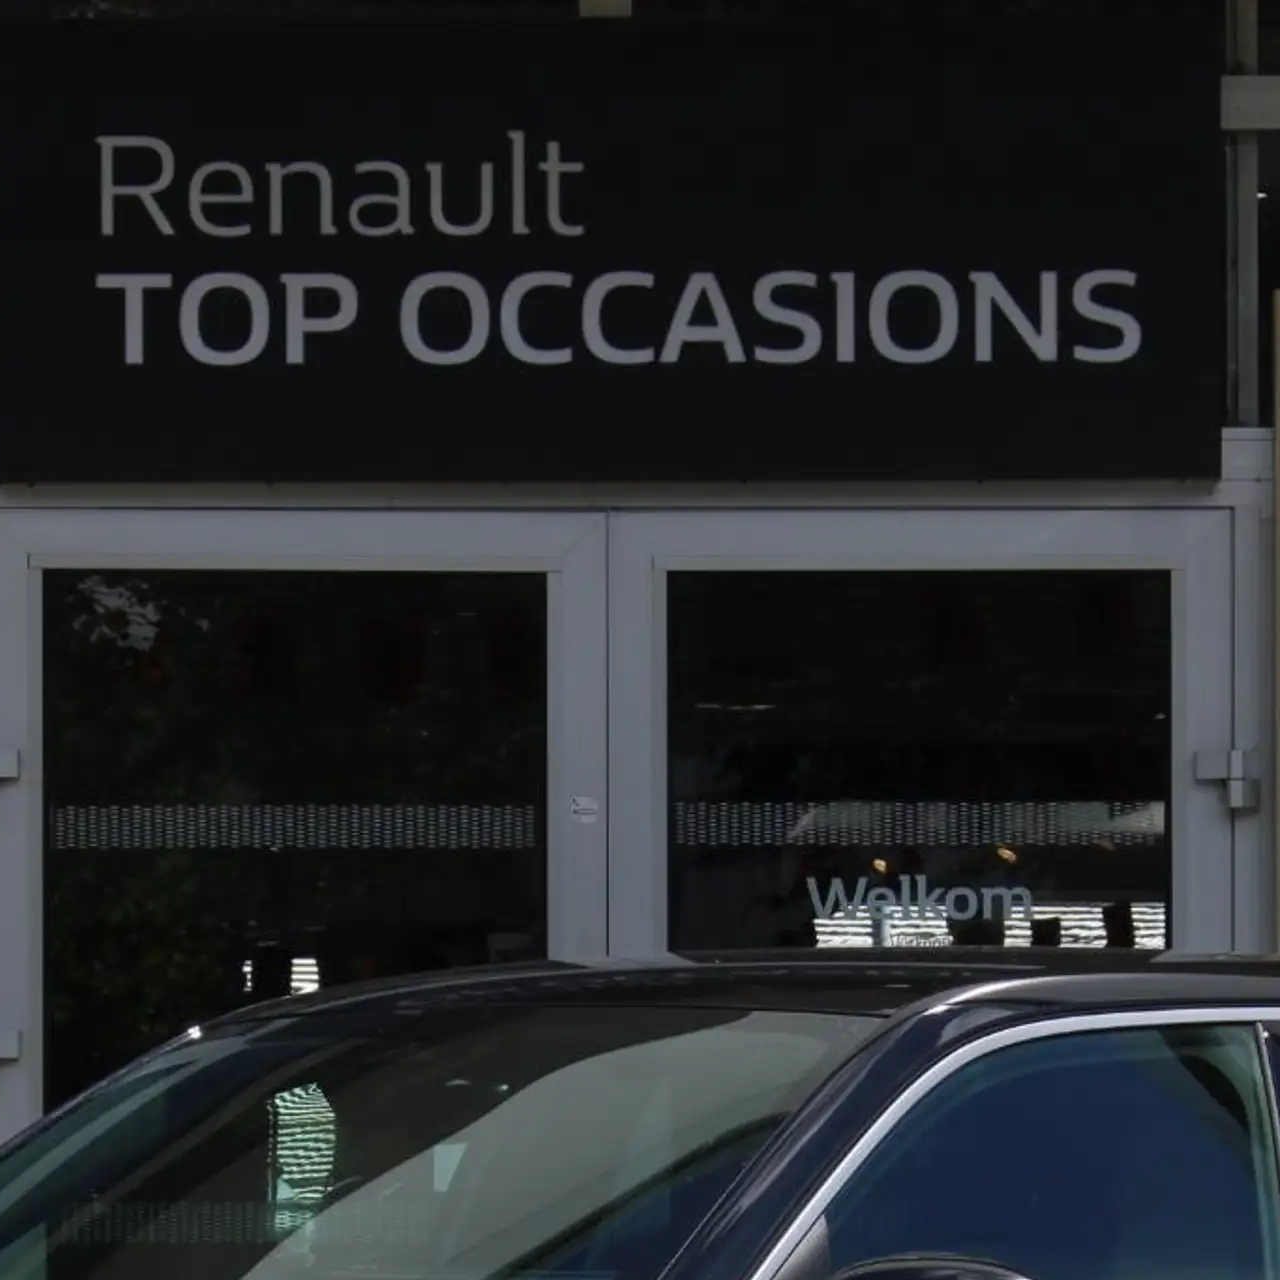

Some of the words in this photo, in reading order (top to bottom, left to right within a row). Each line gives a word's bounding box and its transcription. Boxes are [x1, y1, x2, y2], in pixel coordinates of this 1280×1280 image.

[95, 130, 584, 238] Renault
[95, 272, 359, 366] TOP
[399, 268, 1144, 367] OCCASIONS
[806, 874, 1033, 920] Welkom
